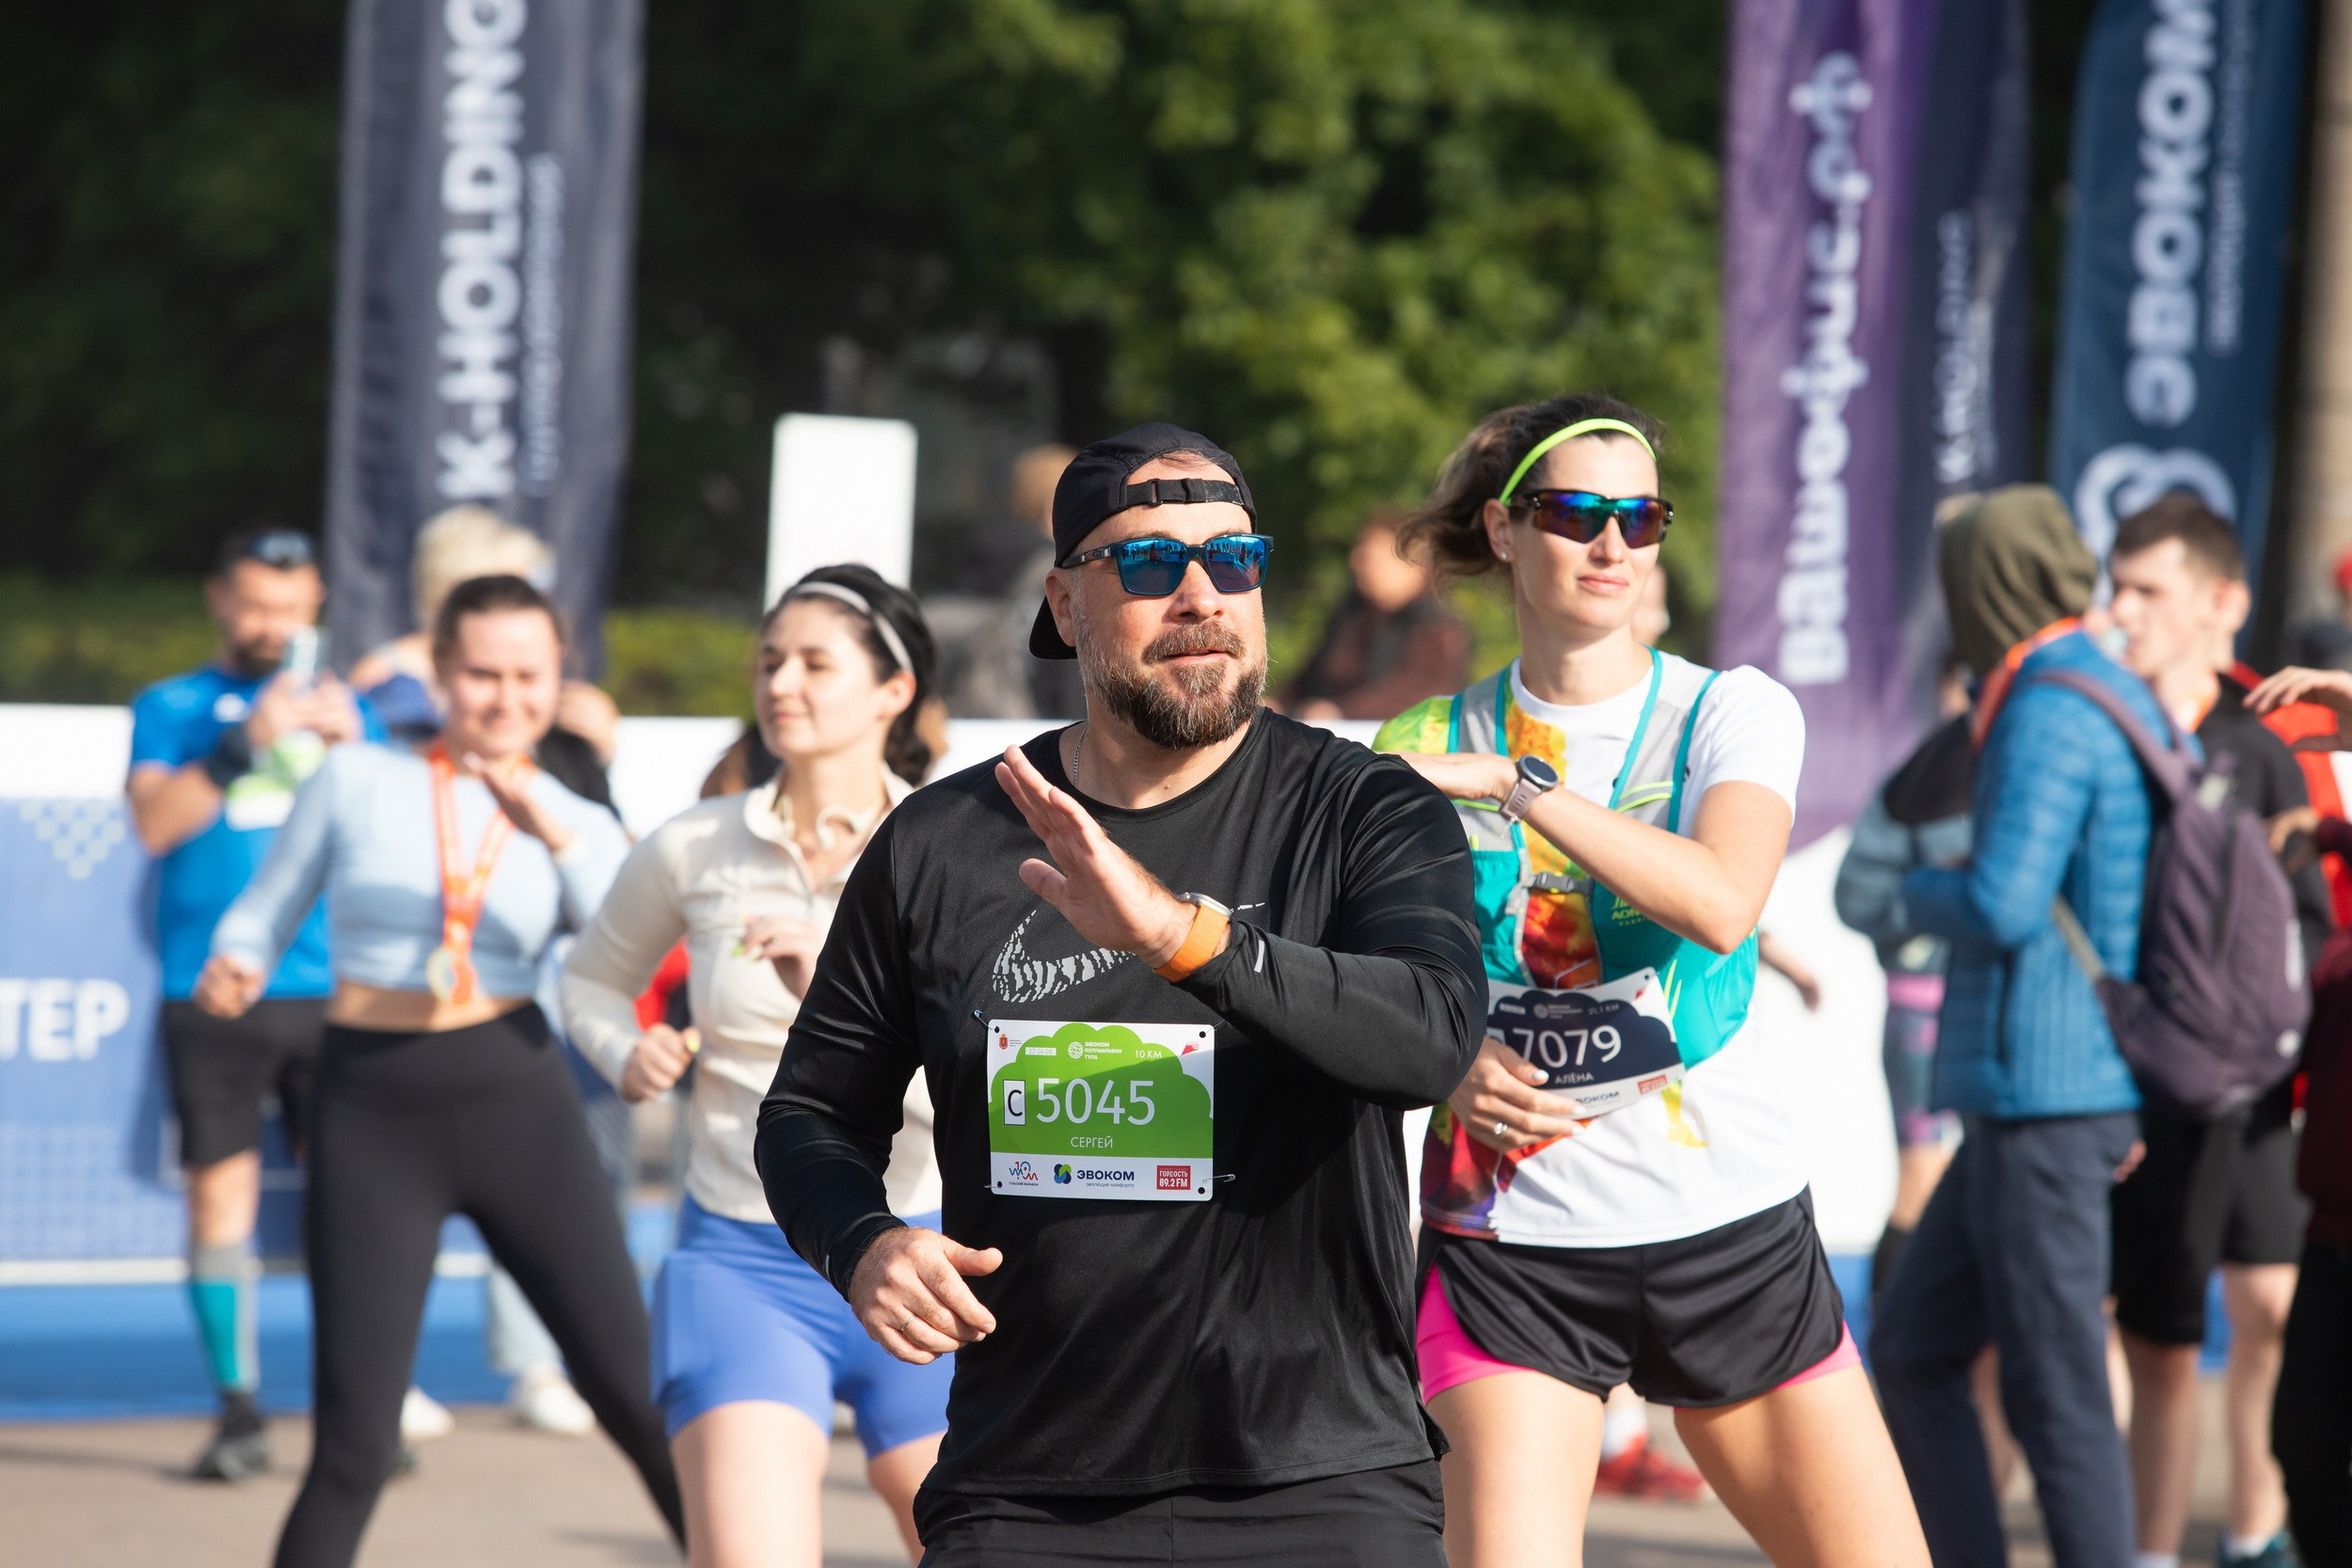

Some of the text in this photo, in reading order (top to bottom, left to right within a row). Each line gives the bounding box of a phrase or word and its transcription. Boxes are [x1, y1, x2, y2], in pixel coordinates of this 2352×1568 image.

[1512, 1024, 1622, 1069] 7079
[1135, 1050, 1162, 1059] 10 КМ
[1008, 1077, 1155, 1126] C 5045
[1071, 1135, 1113, 1148] СЕРГЕЙ
[1077, 1169, 1135, 1181] ЭВОКОМ
[1159, 1178, 1188, 1187] 89.2 FM
